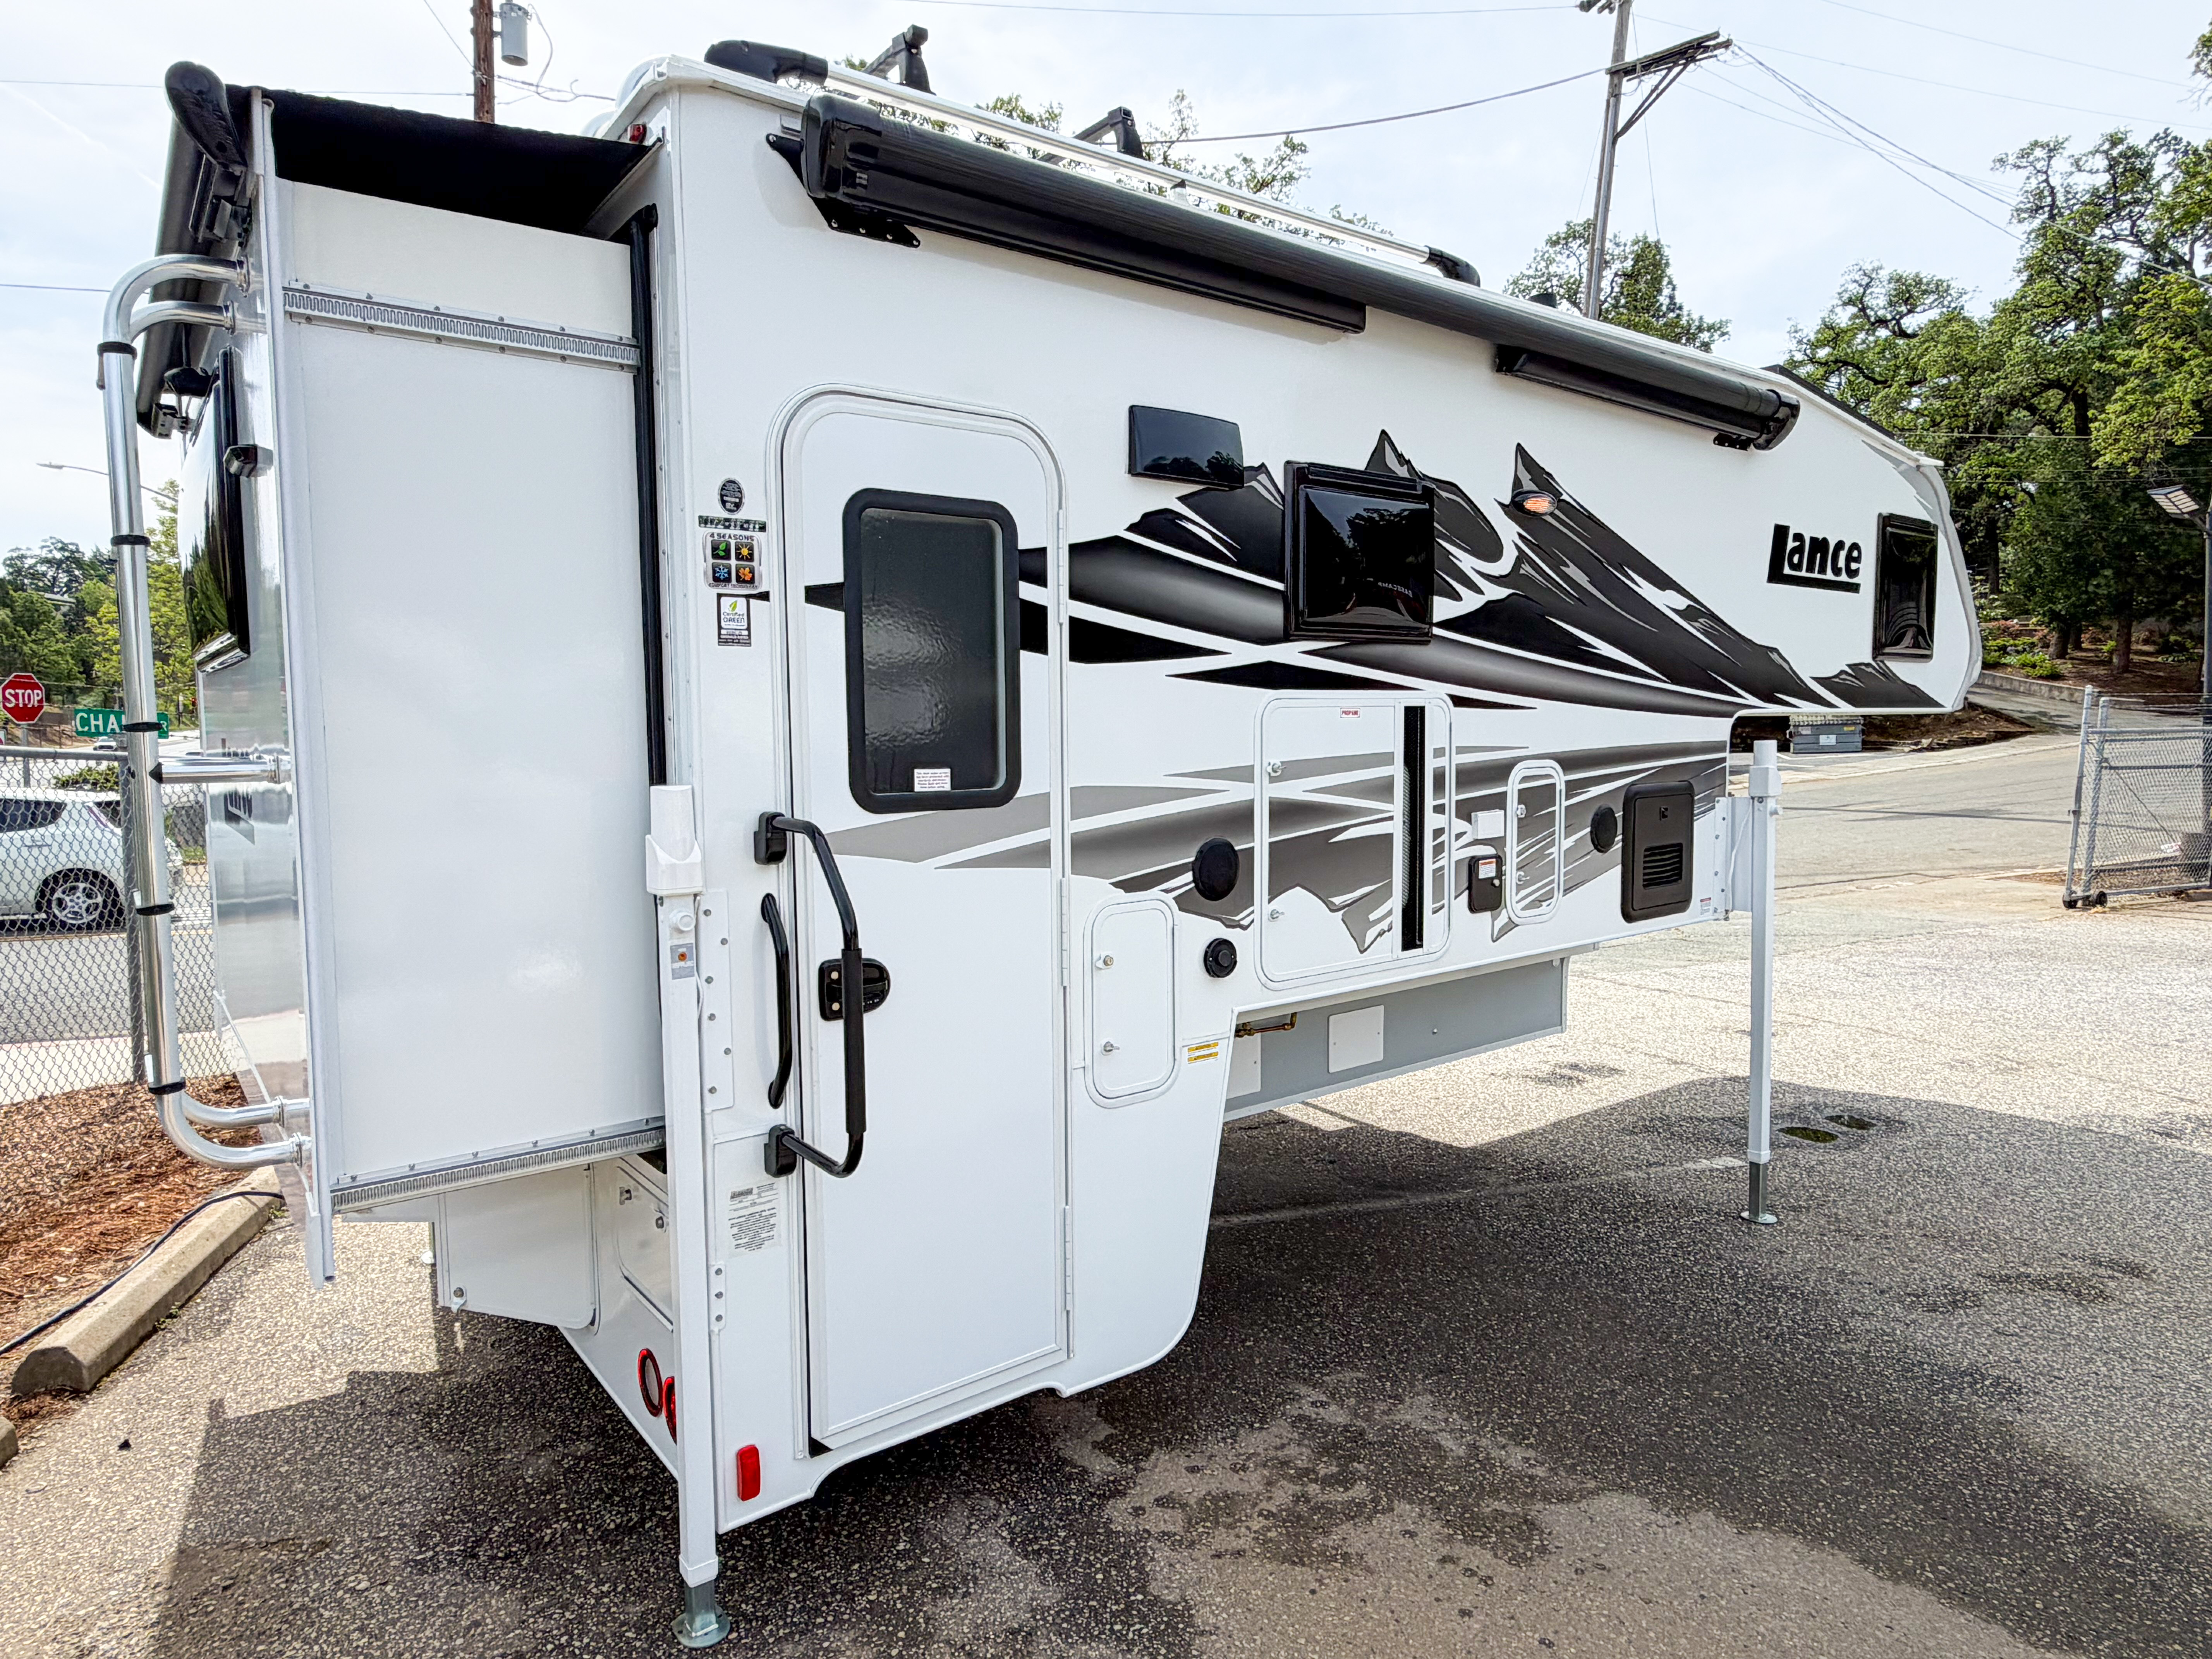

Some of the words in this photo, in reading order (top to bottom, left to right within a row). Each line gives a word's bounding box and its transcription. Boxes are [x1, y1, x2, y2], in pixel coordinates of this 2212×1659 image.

[716, 532, 755, 541] SEASONS
[1767, 523, 1862, 594] Lance
[5, 689, 42, 708] STOP
[76, 713, 126, 733] CHA
